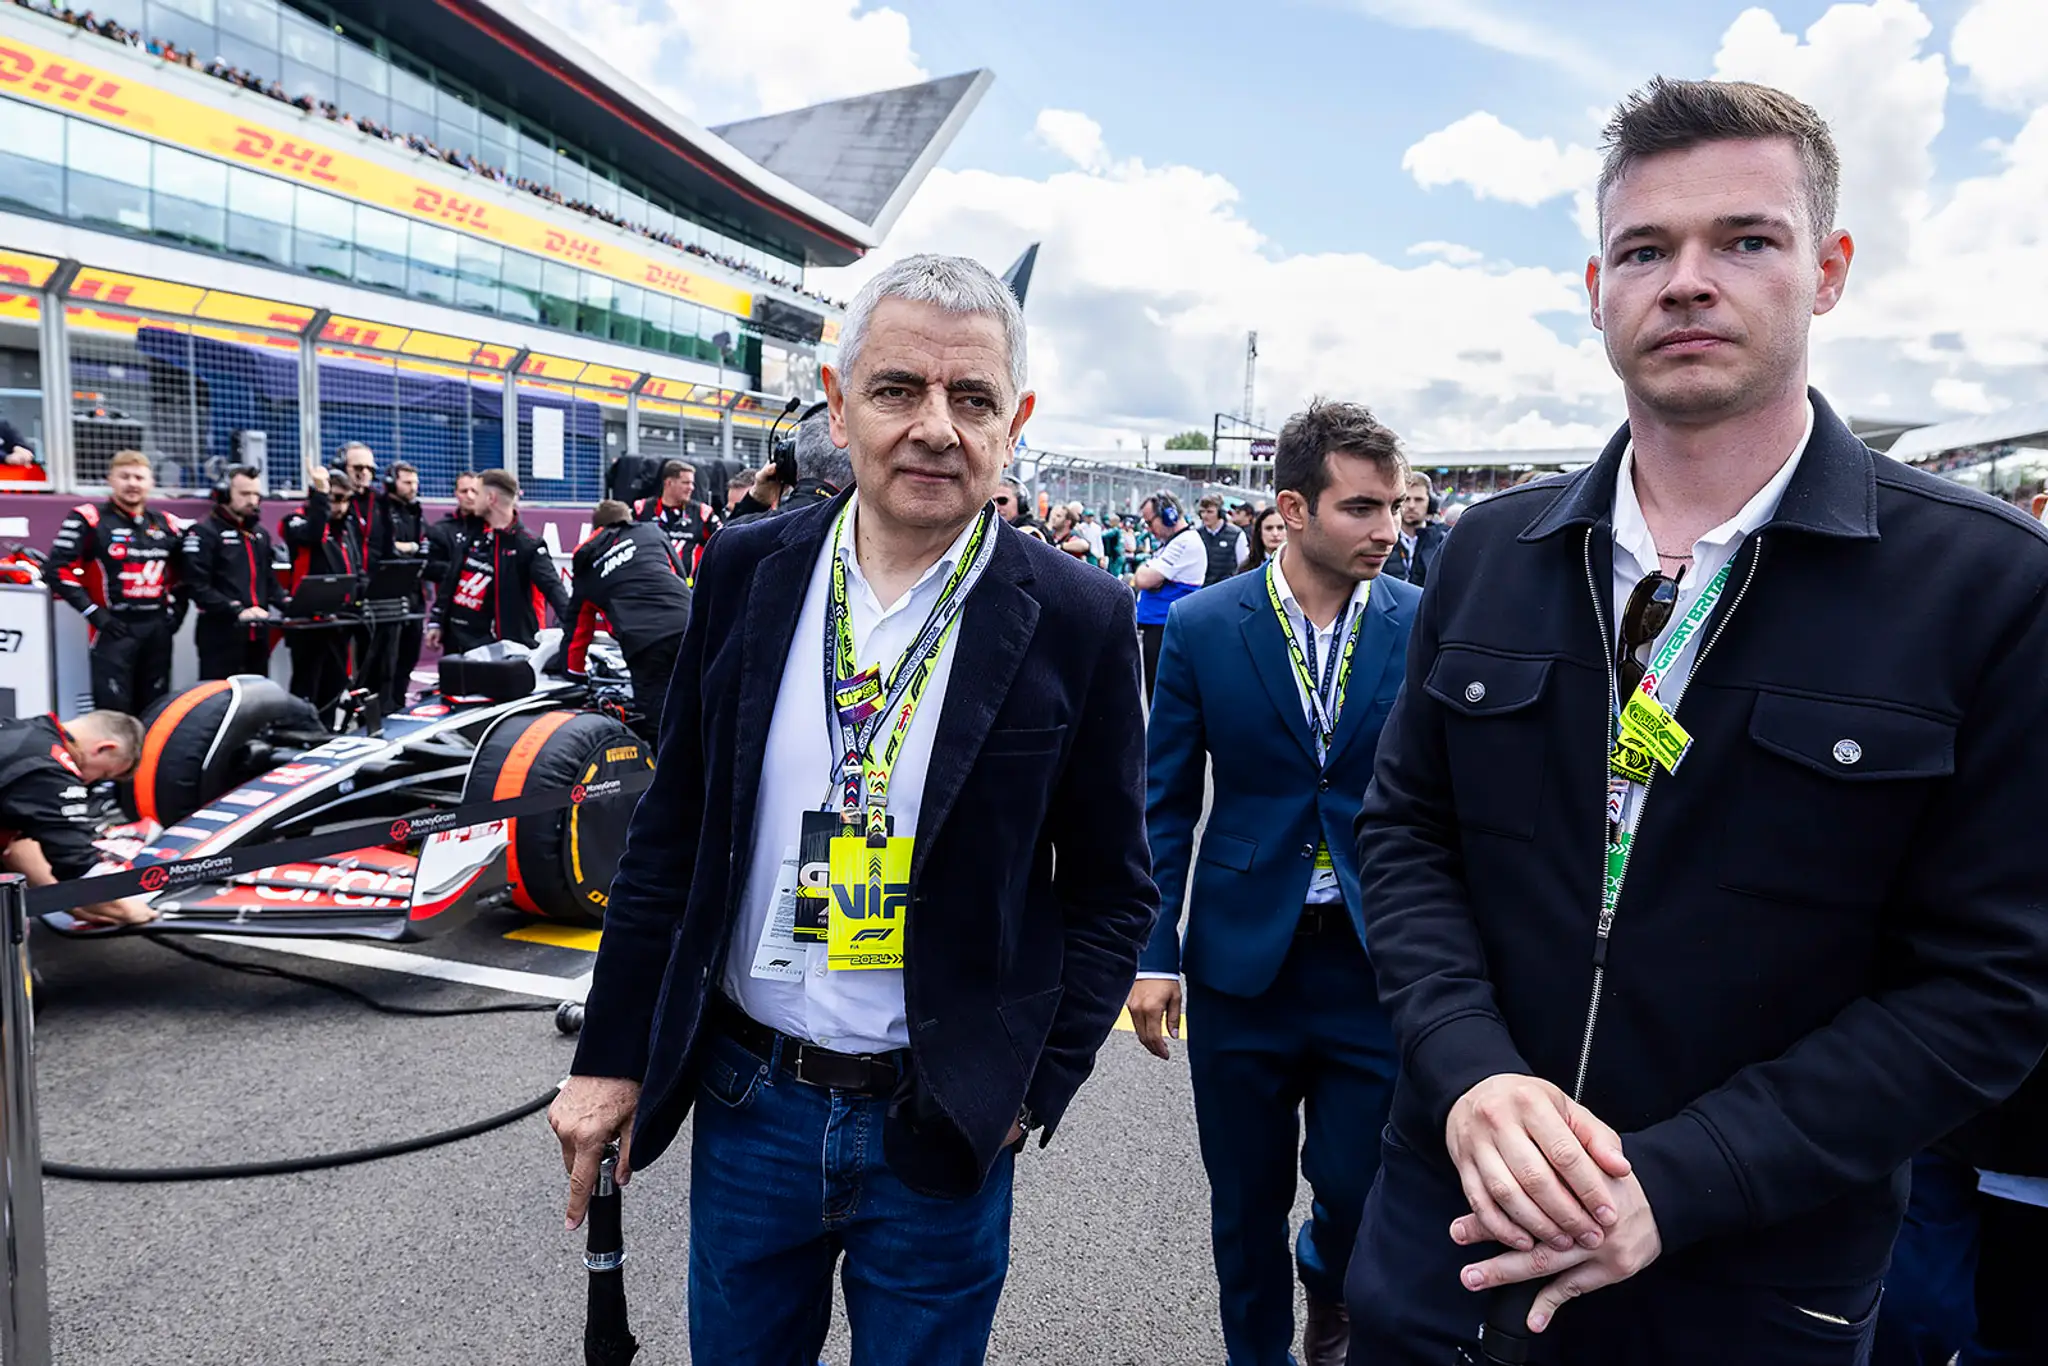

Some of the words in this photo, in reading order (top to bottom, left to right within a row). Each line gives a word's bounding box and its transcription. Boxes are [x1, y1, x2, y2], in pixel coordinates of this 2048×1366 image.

[0, 46, 128, 116] DHL
[233, 126, 338, 182] DHL
[413, 187, 488, 230] DHL
[545, 229, 602, 265] DHL
[645, 263, 692, 294] DHL
[1653, 618, 1694, 671] GREAT
[585, 780, 621, 793] MoneyGram
[410, 812, 457, 829] MoneyGram
[169, 856, 233, 876] MoneyGram
[831, 883, 908, 919] VIP
[753, 964, 784, 973] PADDOCK
[785, 968, 803, 976] CLUB
[850, 954, 891, 966] 2024
